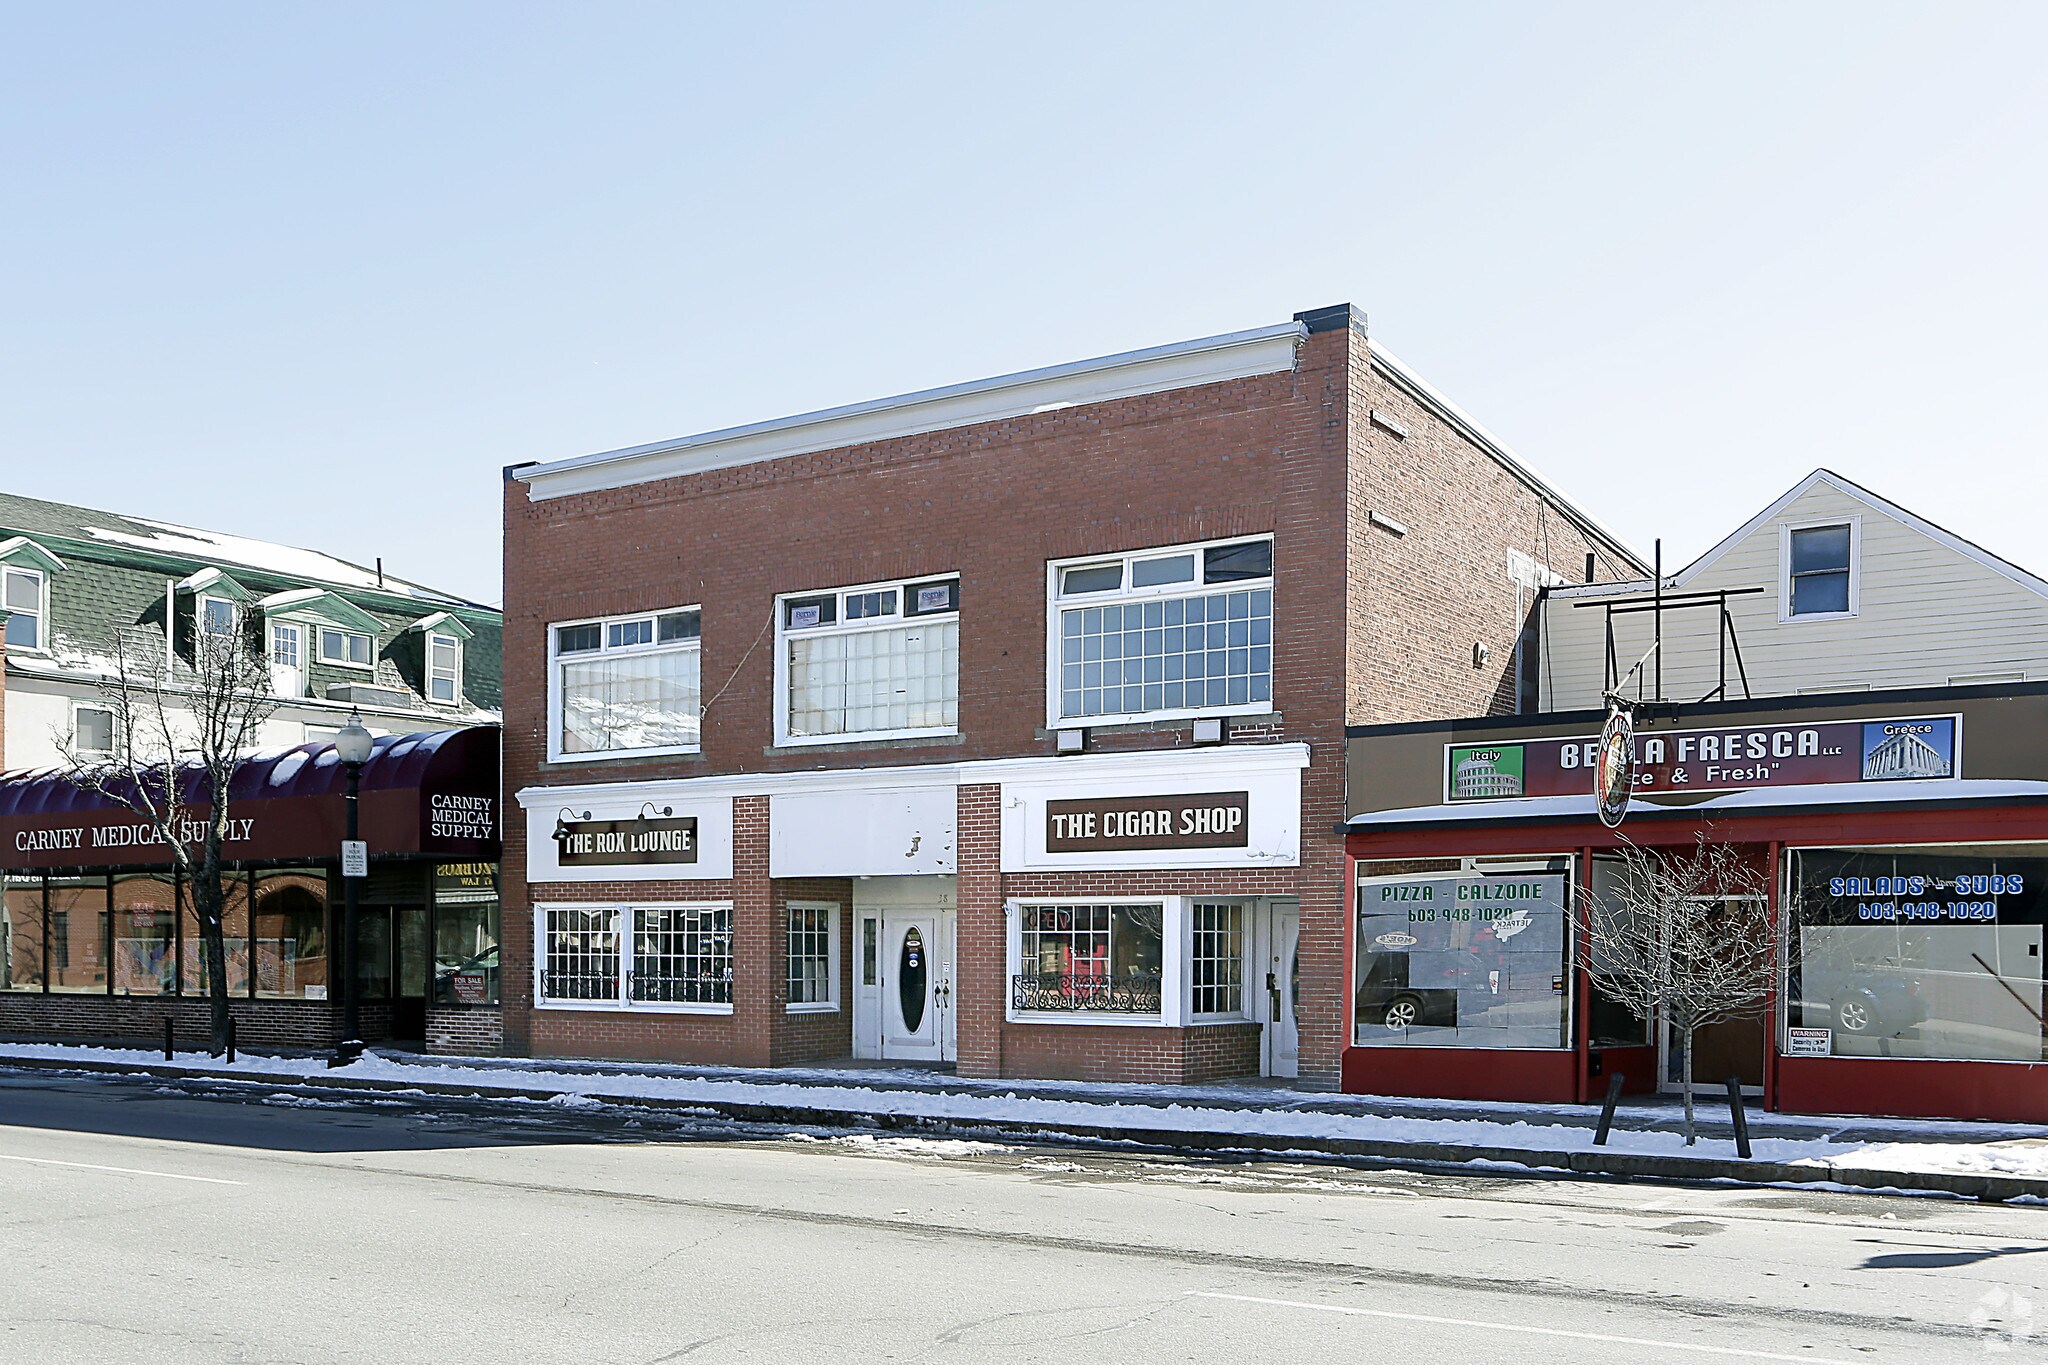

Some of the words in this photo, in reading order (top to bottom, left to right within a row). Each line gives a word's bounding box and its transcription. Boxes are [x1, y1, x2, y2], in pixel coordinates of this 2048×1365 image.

[1884, 725, 1932, 735] Greece
[1471, 750, 1501, 761] Italy
[1560, 738, 1664, 769] BEA
[1678, 729, 1820, 763] FRESCA
[1822, 747, 1842, 755] LLC
[1671, 767, 1689, 784] &
[1706, 762, 1780, 782] Fresh"
[431, 794, 492, 811] CARNEY
[431, 809, 493, 825] MEDICAL
[1051, 812, 1097, 839] THE
[1103, 810, 1174, 837] CIGAR
[1178, 807, 1242, 835] SHOP
[15, 828, 84, 851] CARNEY
[92, 823, 168, 848] MEDICA
[180, 818, 254, 843] SUPLY
[431, 823, 493, 839] SUPPLY
[565, 833, 593, 854] THE
[596, 832, 627, 853] ROX
[630, 830, 691, 852] LOUNGE
[1381, 885, 1433, 901] PIZZA
[1457, 884, 1542, 900] CALZONE
[1829, 876, 1924, 896] SALADS
[1955, 874, 2024, 895] SUBS
[1408, 907, 1514, 922] 603-948-1020
[1859, 902, 1997, 920] 603-948-1020
